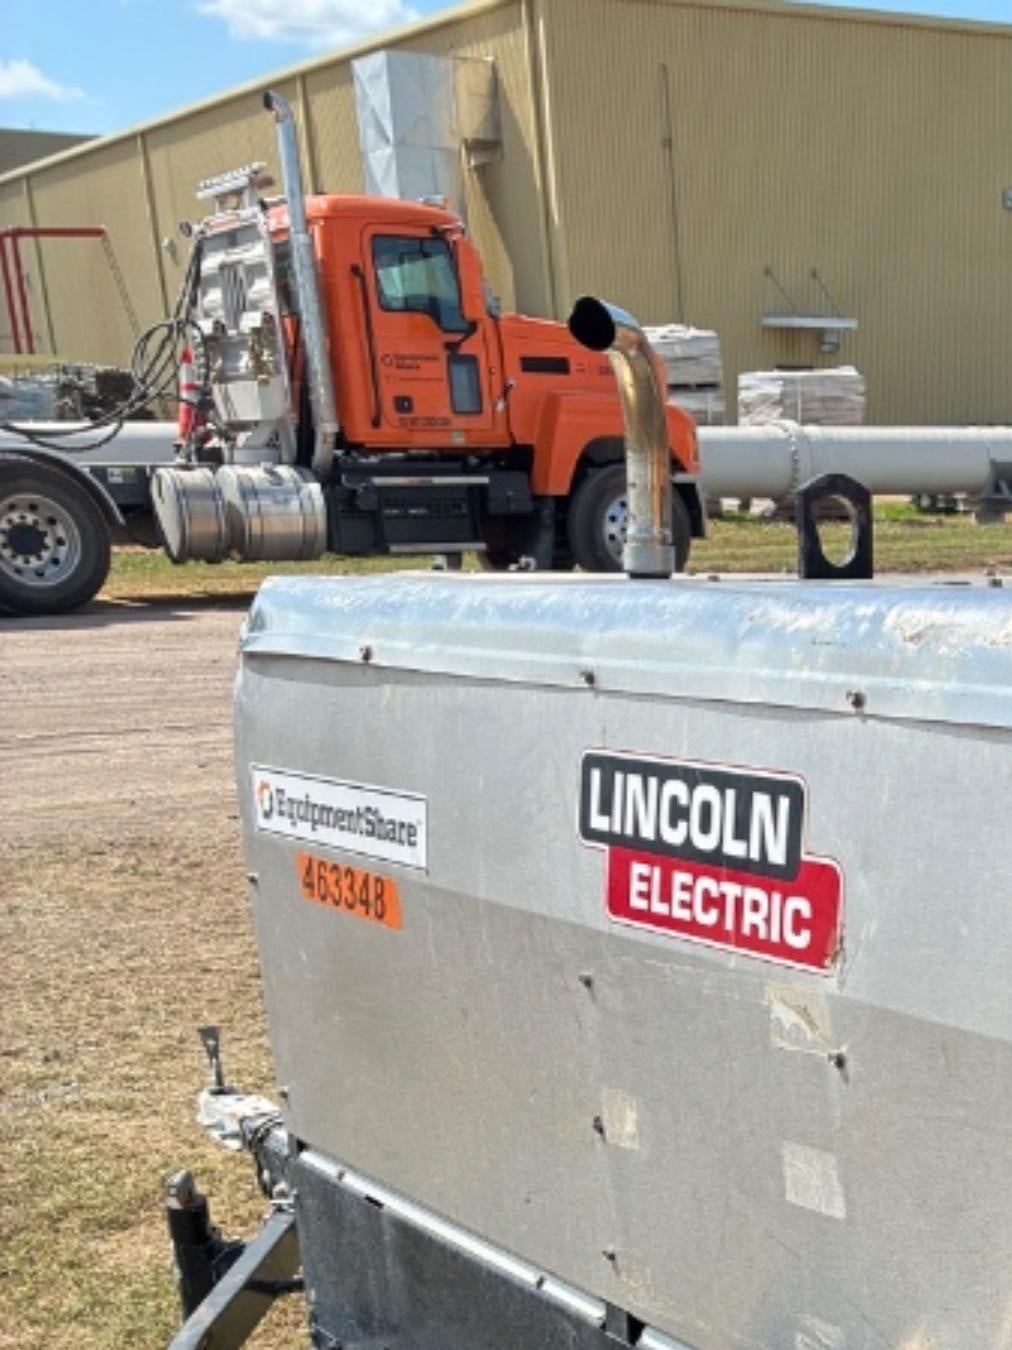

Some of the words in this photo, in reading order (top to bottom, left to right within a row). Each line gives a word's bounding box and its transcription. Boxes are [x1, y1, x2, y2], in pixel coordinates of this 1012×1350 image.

[275, 789, 418, 847] EquipmentShare
[589, 767, 790, 867] LINCOLN
[302, 856, 387, 921] 463348
[628, 860, 813, 950] ELECTRIC
